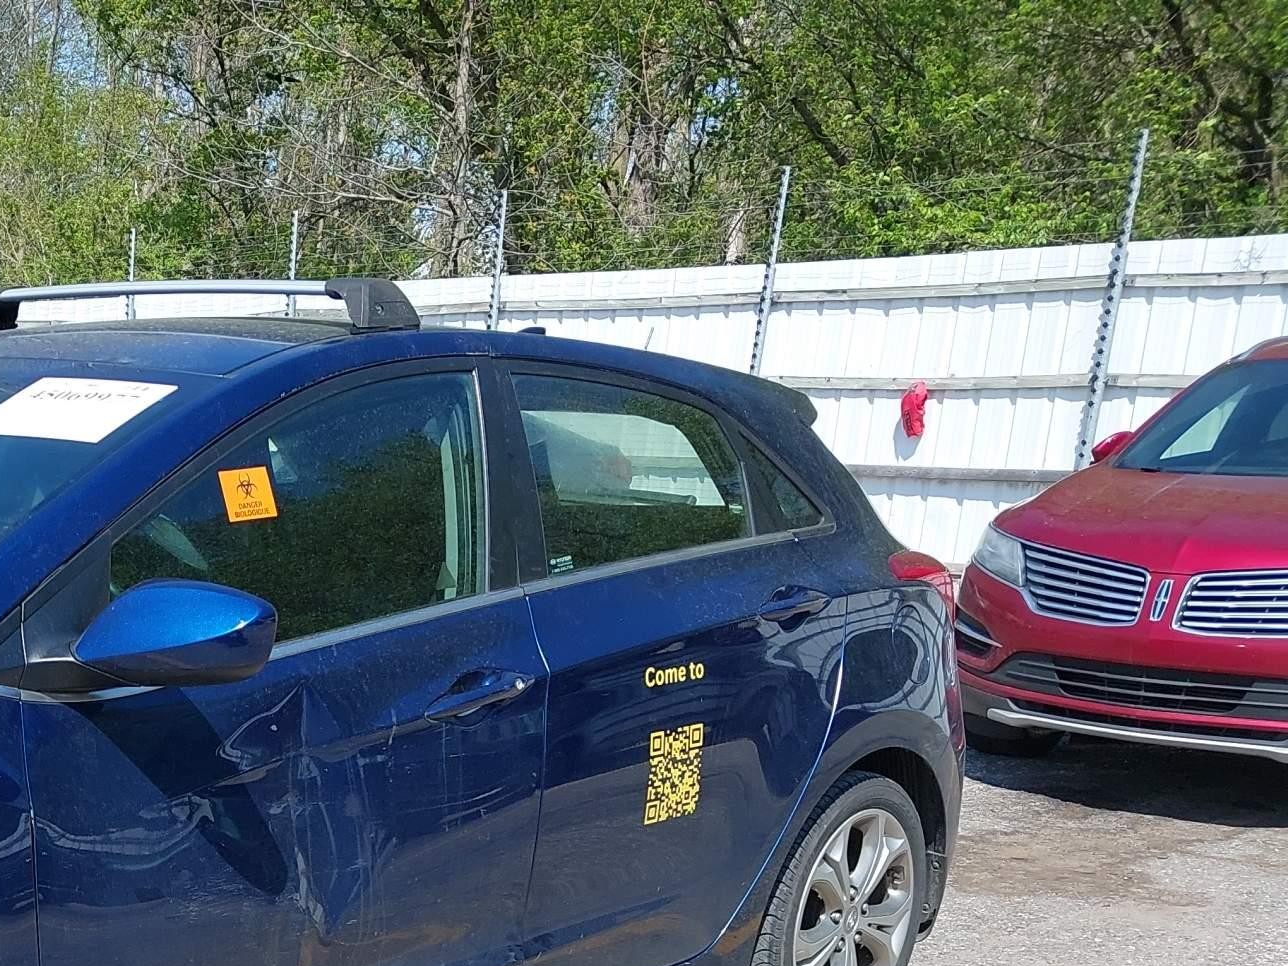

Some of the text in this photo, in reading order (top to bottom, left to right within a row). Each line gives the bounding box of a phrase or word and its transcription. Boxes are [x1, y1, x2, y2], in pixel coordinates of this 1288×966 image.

[238, 501, 263, 510] DANGER
[645, 662, 705, 688] Come to
